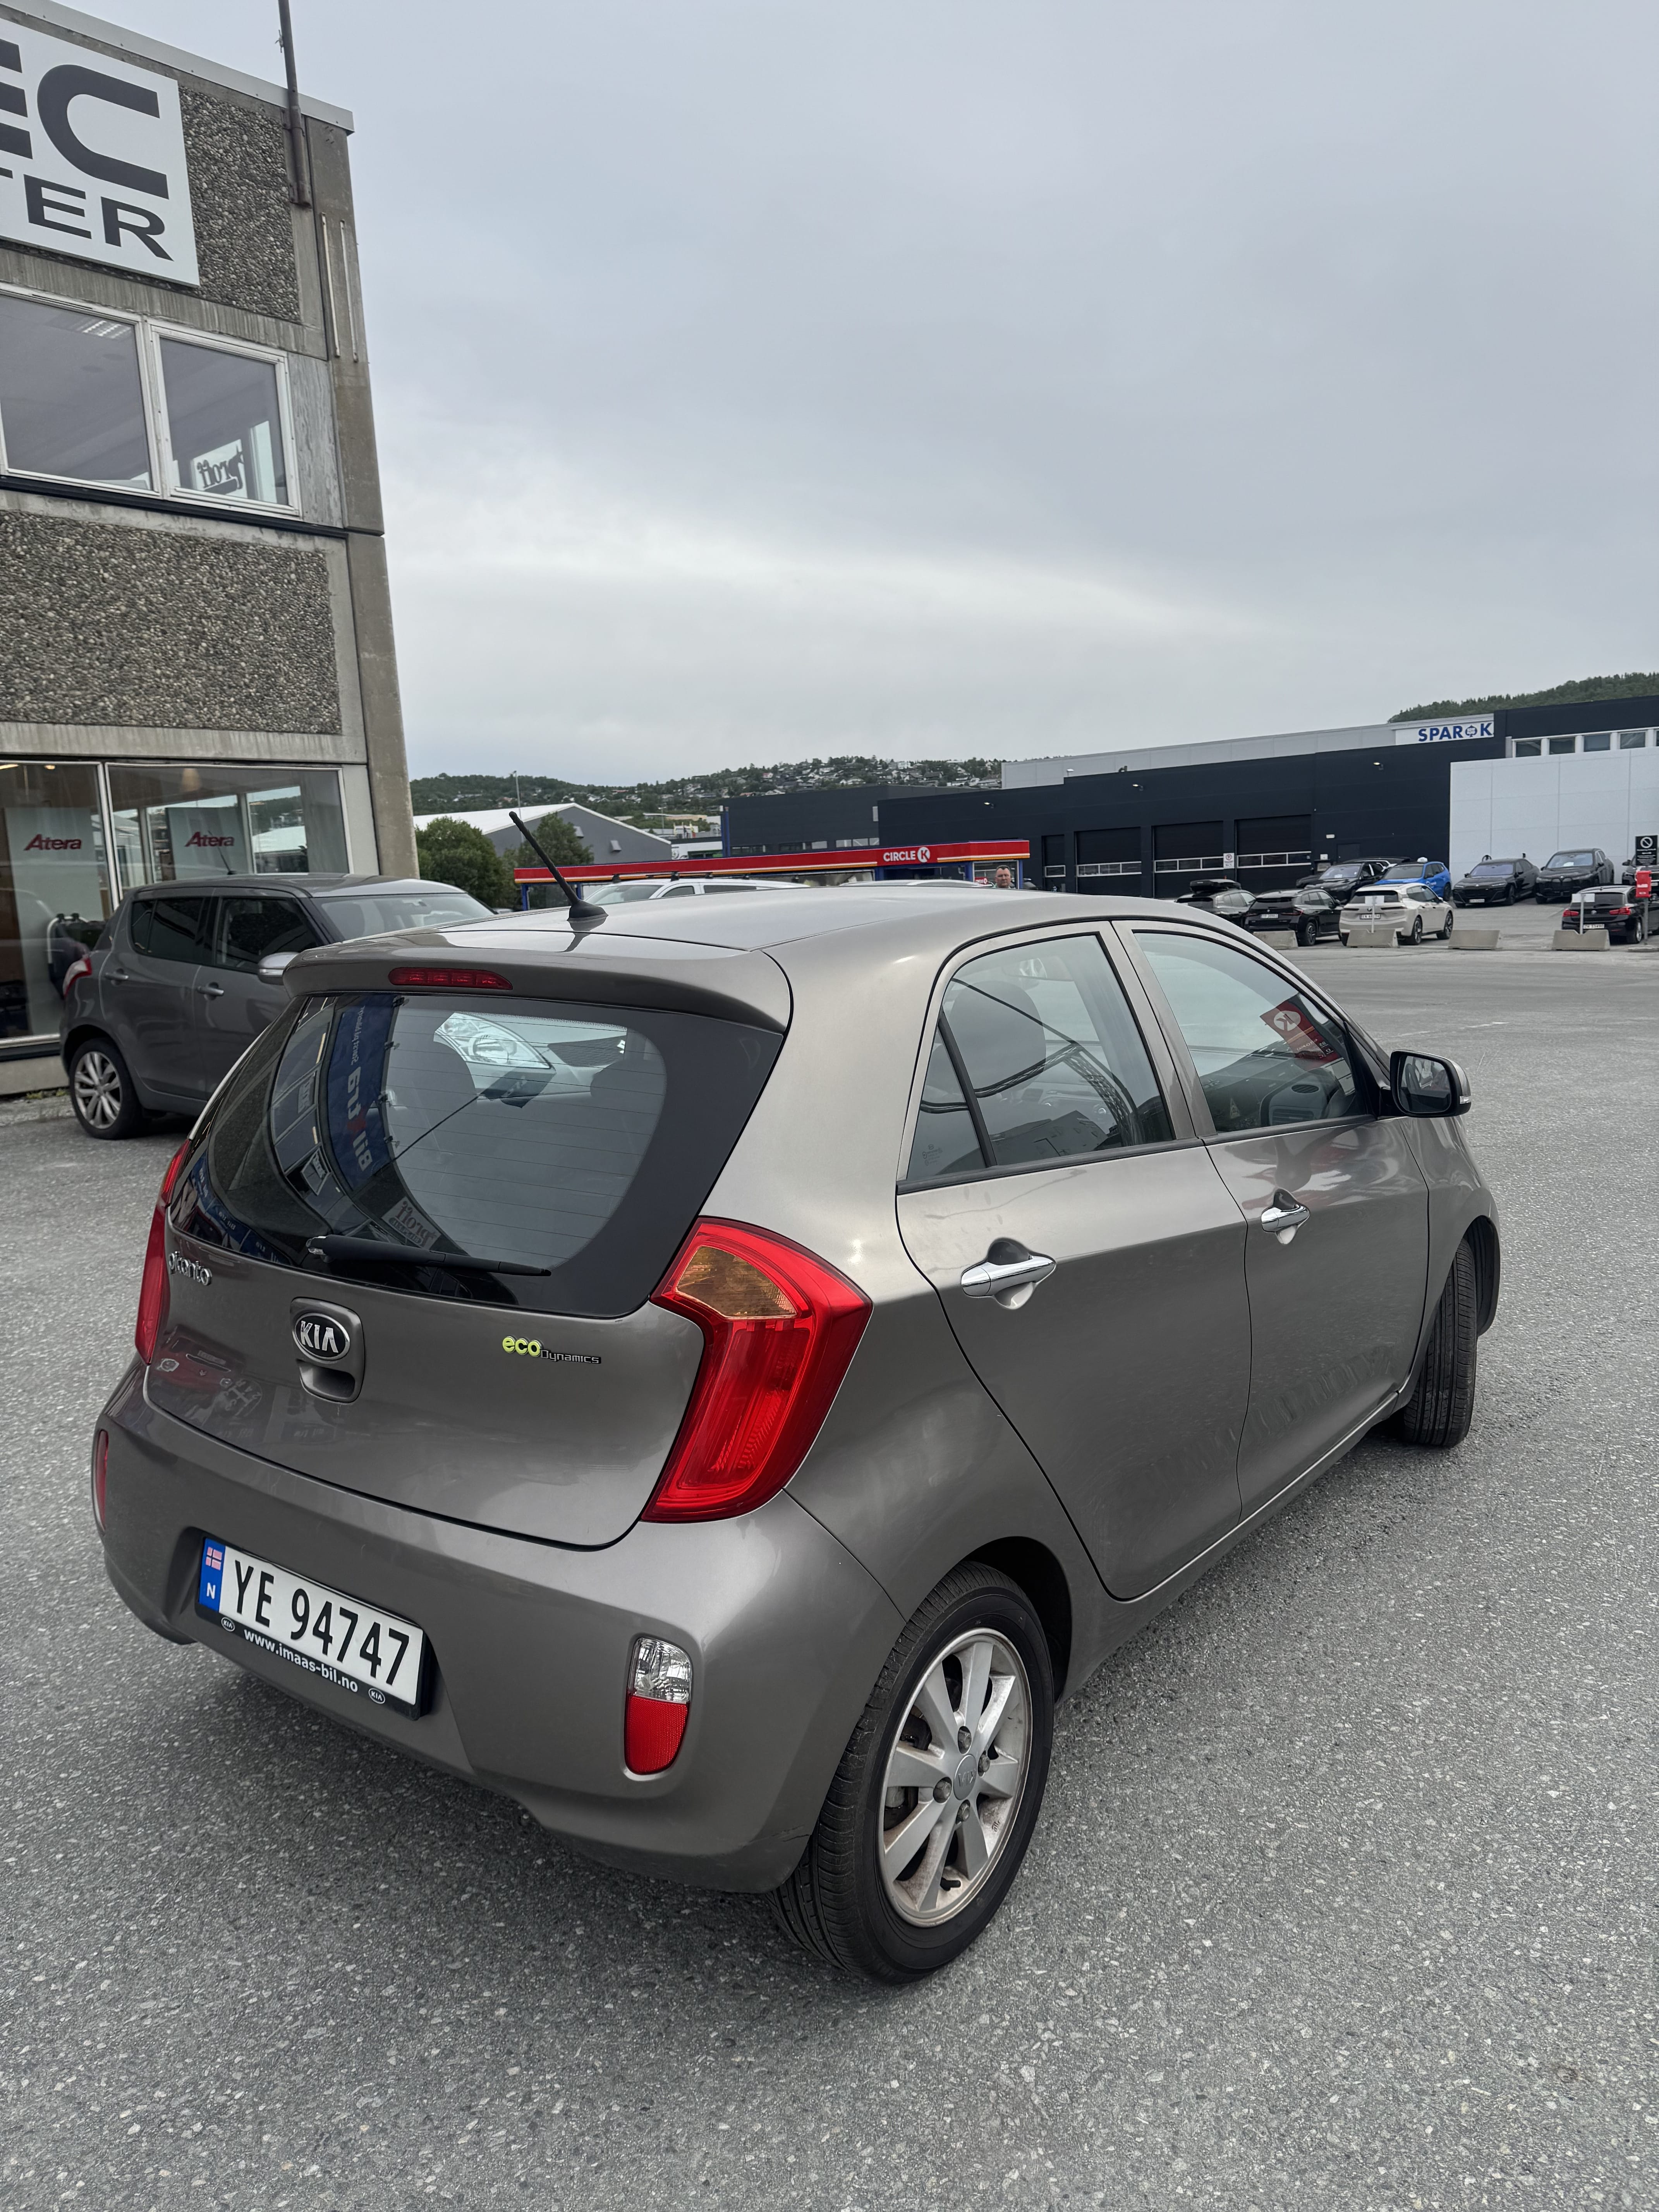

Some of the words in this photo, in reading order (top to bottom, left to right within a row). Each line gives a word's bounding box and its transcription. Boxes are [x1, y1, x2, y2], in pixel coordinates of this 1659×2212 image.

[0, 167, 174, 261] ER
[24, 834, 82, 850] Atera
[185, 831, 234, 847] Atera
[883, 850, 916, 862] CIRCLE
[919, 848, 930, 862] K
[301, 1321, 338, 1353] KIA
[502, 1336, 541, 1357] eco
[206, 1582, 216, 1599] N
[222, 1619, 234, 1630] KIA
[235, 1560, 274, 1628] YE
[290, 1588, 409, 1686] 94747
[244, 1629, 358, 1693] www.imaas-bil.no
[370, 1691, 383, 1702] KIA
